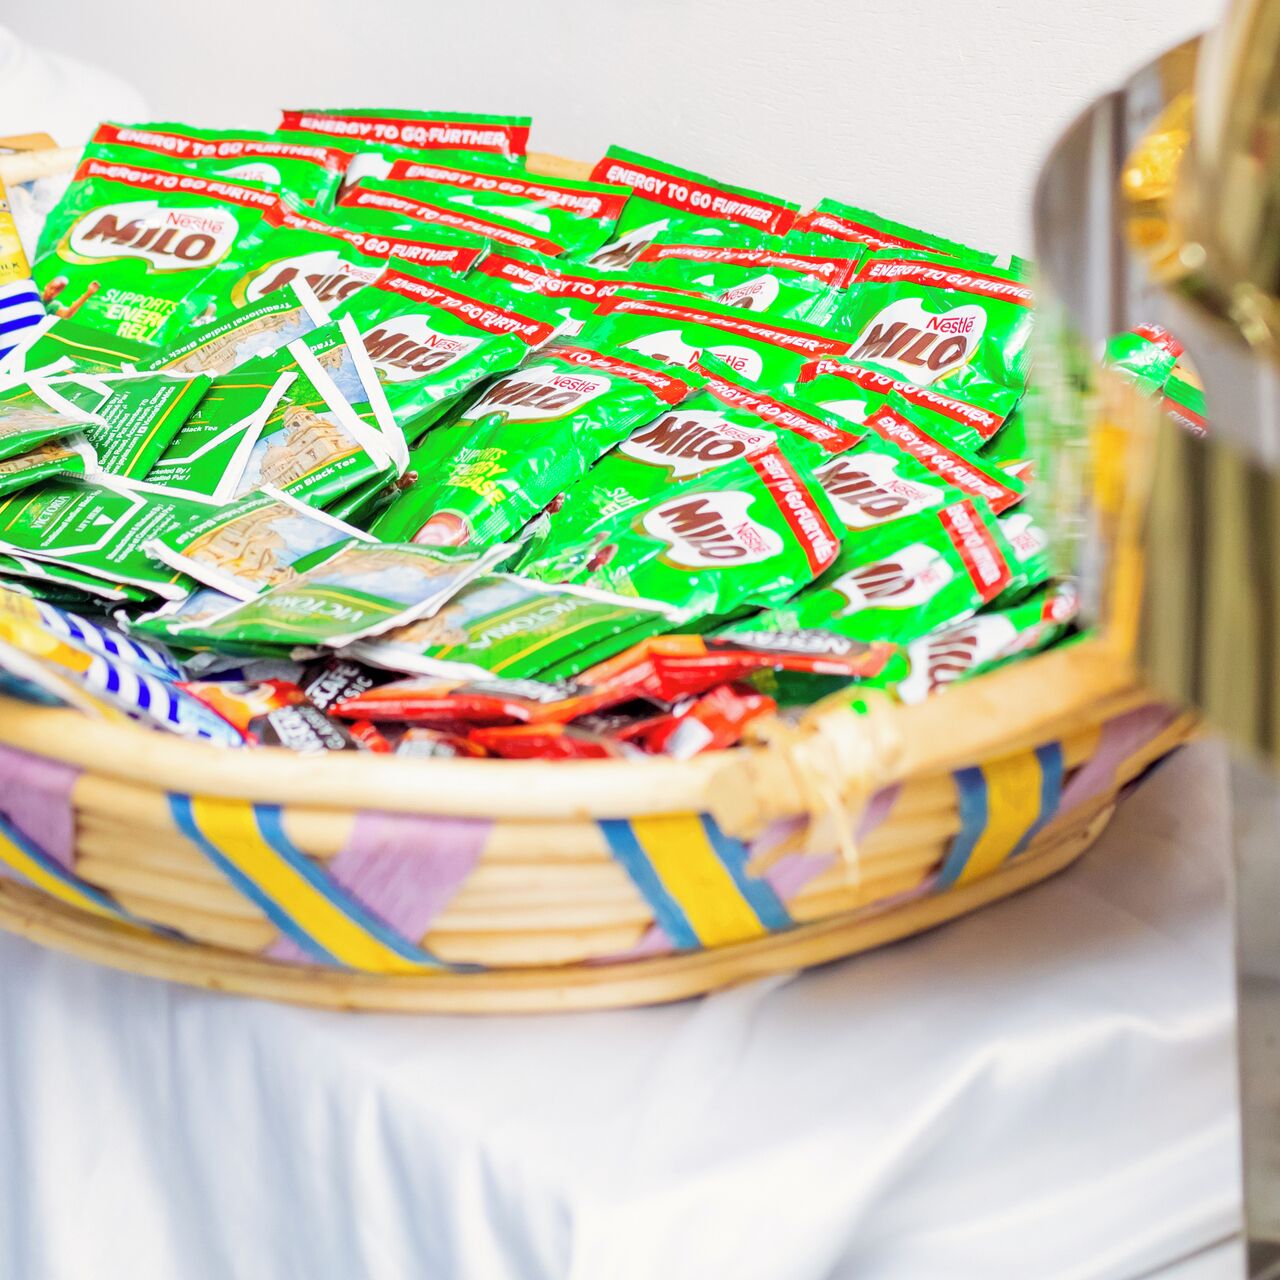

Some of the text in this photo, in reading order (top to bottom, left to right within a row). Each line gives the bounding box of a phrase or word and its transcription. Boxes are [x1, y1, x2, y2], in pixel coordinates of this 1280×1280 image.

[117, 130, 328, 161] ENERGY TO GO FURTHER
[300, 118, 507, 146] ENERGY TO GO FURTHER
[155, 175, 179, 188] TO
[180, 178, 207, 189] GO
[207, 182, 277, 206] FURTHE
[405, 166, 601, 213] ENERGY TO GO FURTHER
[606, 165, 773, 223] ENERGY TO GO FURTHER
[417, 208, 439, 220] TO
[81, 214, 216, 261] MILO
[364, 238, 390, 253] GO
[390, 243, 458, 261] FURTHER
[572, 282, 595, 295] TO
[597, 285, 618, 297] GO
[870, 263, 926, 277] ENERGY
[923, 266, 946, 281] TO
[945, 272, 972, 286] GO
[389, 278, 443, 300] ENERGY
[441, 295, 461, 306] TO
[460, 304, 481, 318] GO
[150, 302, 292, 370] Traditional Indian Black Tea
[737, 323, 820, 351] FURTHER
[926, 316, 976, 334] Nestlé
[362, 329, 456, 371] MILO
[850, 321, 968, 370] MILO
[470, 380, 581, 410] MILO
[549, 374, 600, 394] Nestlé
[756, 404, 779, 417] GO
[871, 374, 891, 384] TO
[892, 381, 917, 393] GO
[917, 388, 994, 426] FURTHER
[630, 416, 746, 461] MILO
[304, 457, 357, 486] Black Tea
[919, 444, 938, 456] TO
[932, 455, 955, 470] GO
[815, 461, 909, 518] MILO
[30, 495, 71, 529] VICTORIA
[658, 499, 747, 559] MILO
